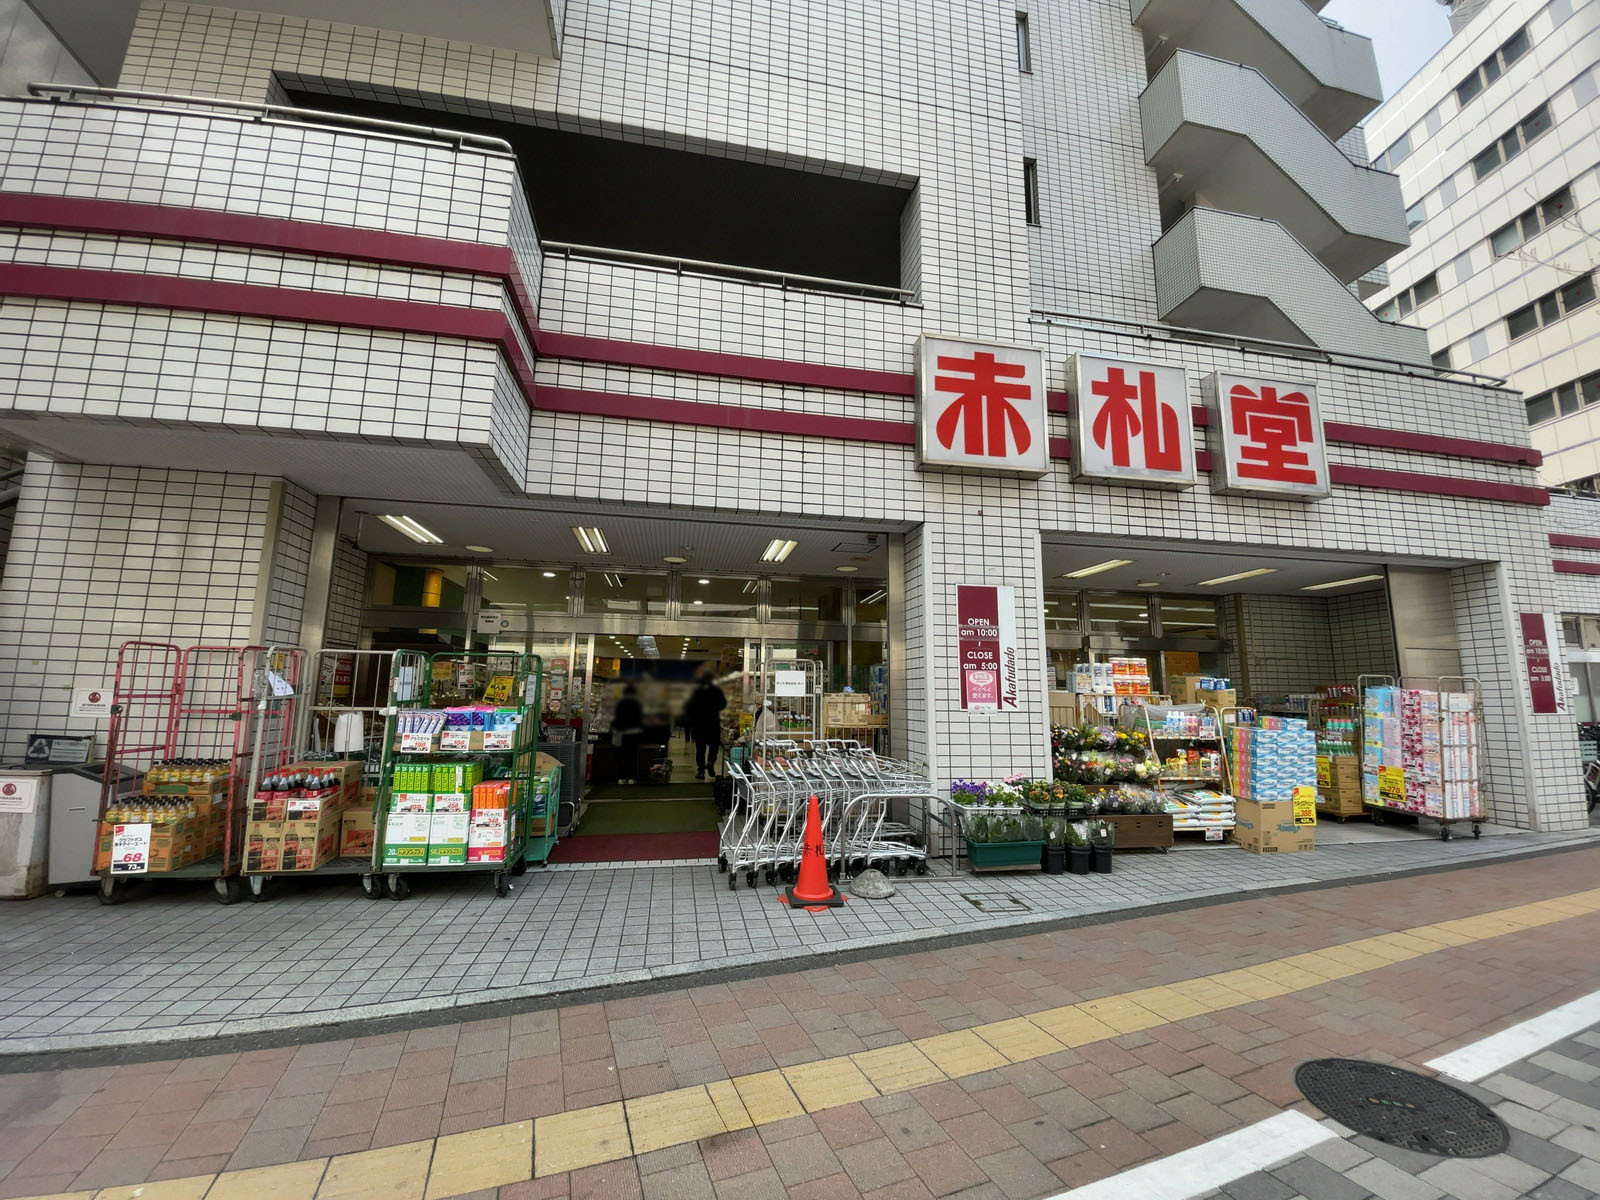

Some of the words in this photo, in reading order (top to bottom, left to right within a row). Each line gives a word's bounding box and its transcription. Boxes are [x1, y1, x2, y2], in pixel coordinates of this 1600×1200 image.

[934, 352, 1318, 486] 赤札堂
[967, 617, 990, 626] OPEN
[976, 628, 998, 637] 10:00
[967, 651, 993, 660] CLOSE
[981, 662, 998, 670] 5:00
[1003, 646, 1017, 708] Akafudado
[1553, 662, 1567, 711] Akafudado
[803, 843, 825, 857] 赤札
[123, 852, 143, 863] 68
